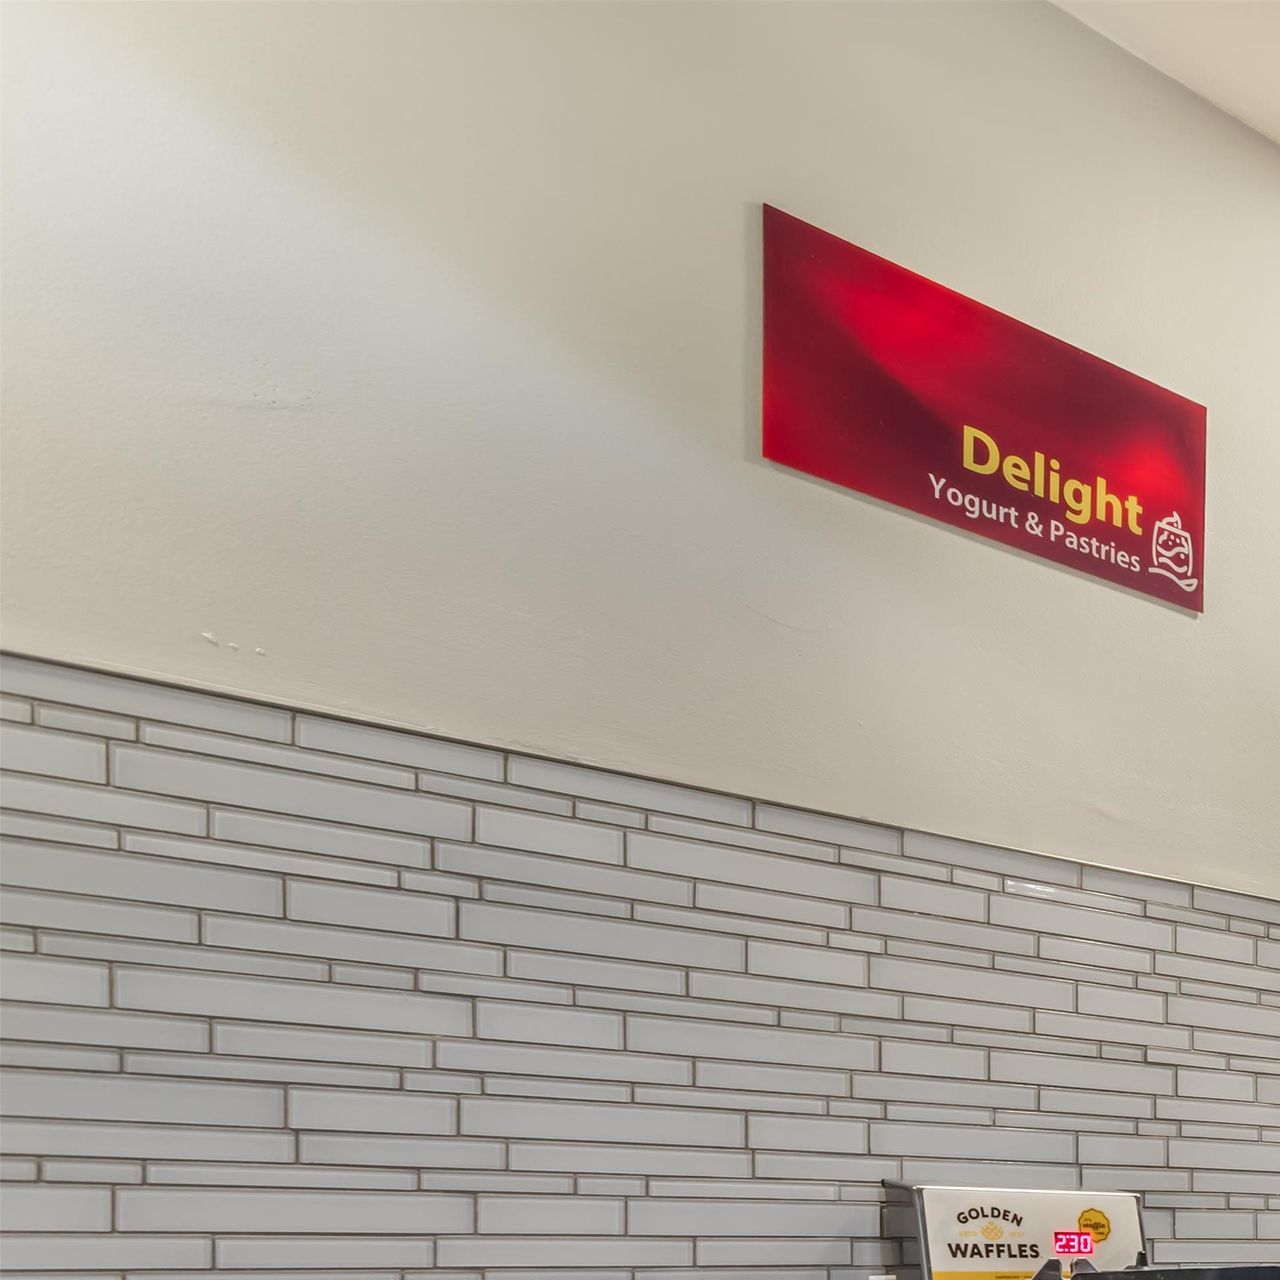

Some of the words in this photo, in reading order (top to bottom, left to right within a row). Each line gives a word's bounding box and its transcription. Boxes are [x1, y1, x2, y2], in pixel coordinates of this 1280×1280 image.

[962, 424, 1143, 536] Delight
[928, 472, 1019, 529] Yogurt
[1024, 511, 1044, 538] &
[1049, 519, 1141, 573] Pastries
[956, 1206, 1024, 1228] GOLDEN
[946, 1242, 1040, 1259] WAFFLES
[1055, 1234, 1092, 1252] 2:30
